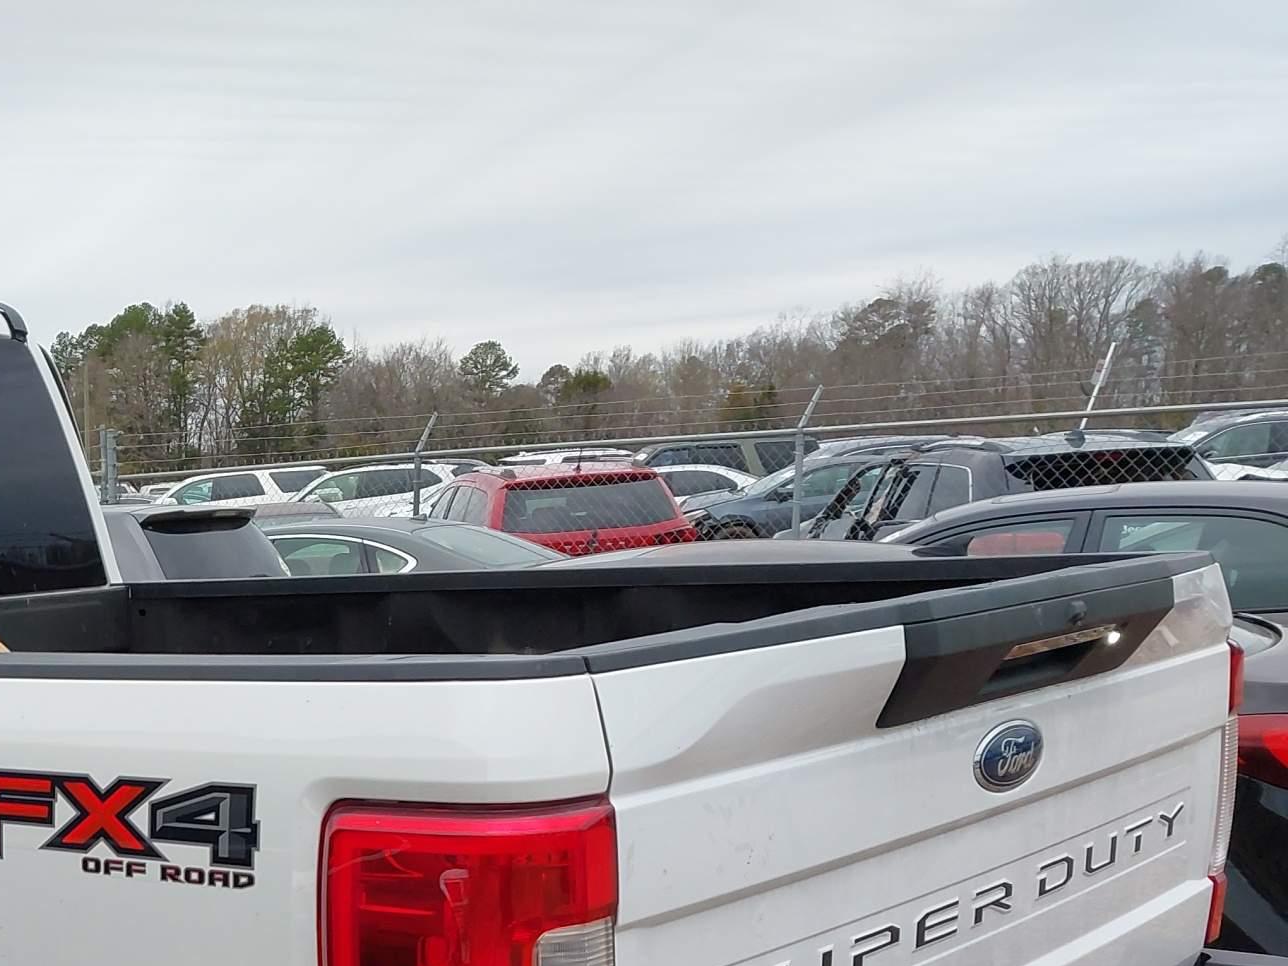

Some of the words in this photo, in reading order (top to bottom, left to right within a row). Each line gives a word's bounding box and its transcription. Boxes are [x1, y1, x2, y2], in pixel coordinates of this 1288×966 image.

[997, 736, 1034, 777] Ford
[1037, 801, 1185, 898] DUTY
[81, 857, 147, 879] OFF
[160, 863, 256, 889] ROAD
